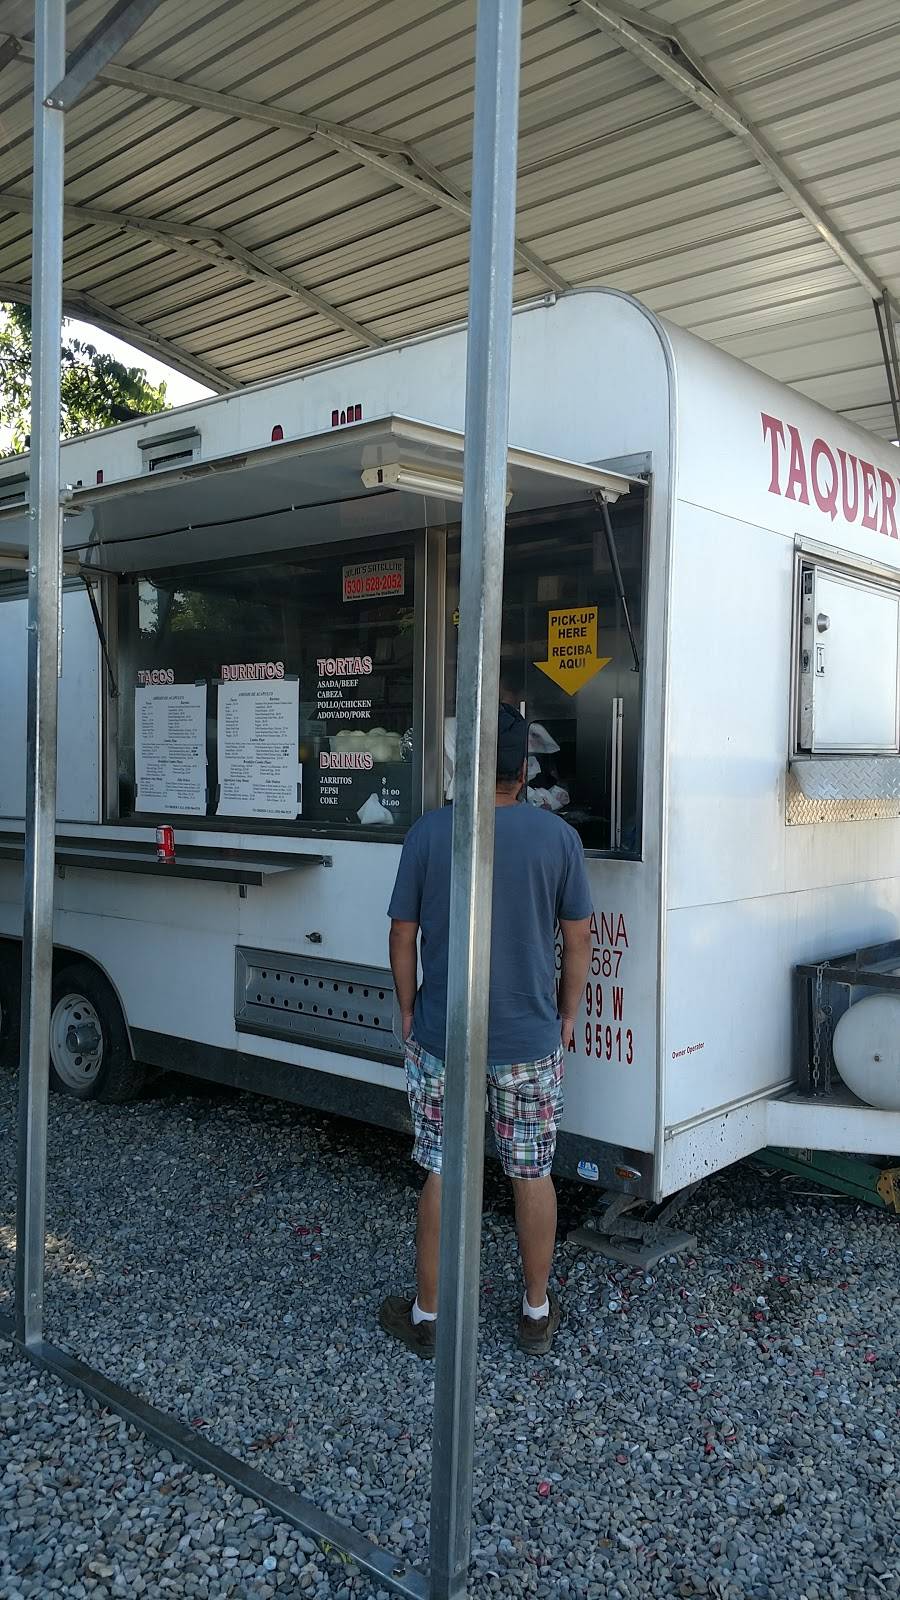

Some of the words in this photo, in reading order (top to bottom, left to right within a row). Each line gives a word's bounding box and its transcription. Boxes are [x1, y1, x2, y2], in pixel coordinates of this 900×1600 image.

[761, 412, 900, 539] TAQUER
[551, 613, 595, 626] PICK-UP
[558, 626, 587, 639] HERE
[552, 644, 592, 657] RECIBA
[316, 655, 373, 677] TORTAS
[559, 658, 586, 669] AQUI
[137, 668, 175, 685] TACOS
[221, 661, 285, 681] BURRITOS
[316, 679, 359, 688] ASADA/BEEF
[317, 690, 343, 699] CABEZA
[317, 700, 372, 709] POLLO/CHICKEN
[316, 710, 371, 720] ADOVADO/PORK
[319, 752, 374, 770] DRINKS
[320, 776, 353, 785] JARRITOS
[320, 786, 339, 795] PEPSI
[319, 796, 339, 805] COKE
[589, 911, 629, 948] ANA
[591, 948, 623, 978] 587
[585, 982, 603, 1018] 99
[612, 986, 624, 1021] W
[585, 1022, 634, 1065] 95913
[672, 1049, 687, 1060] Owner
[687, 1042, 705, 1055] Operator
